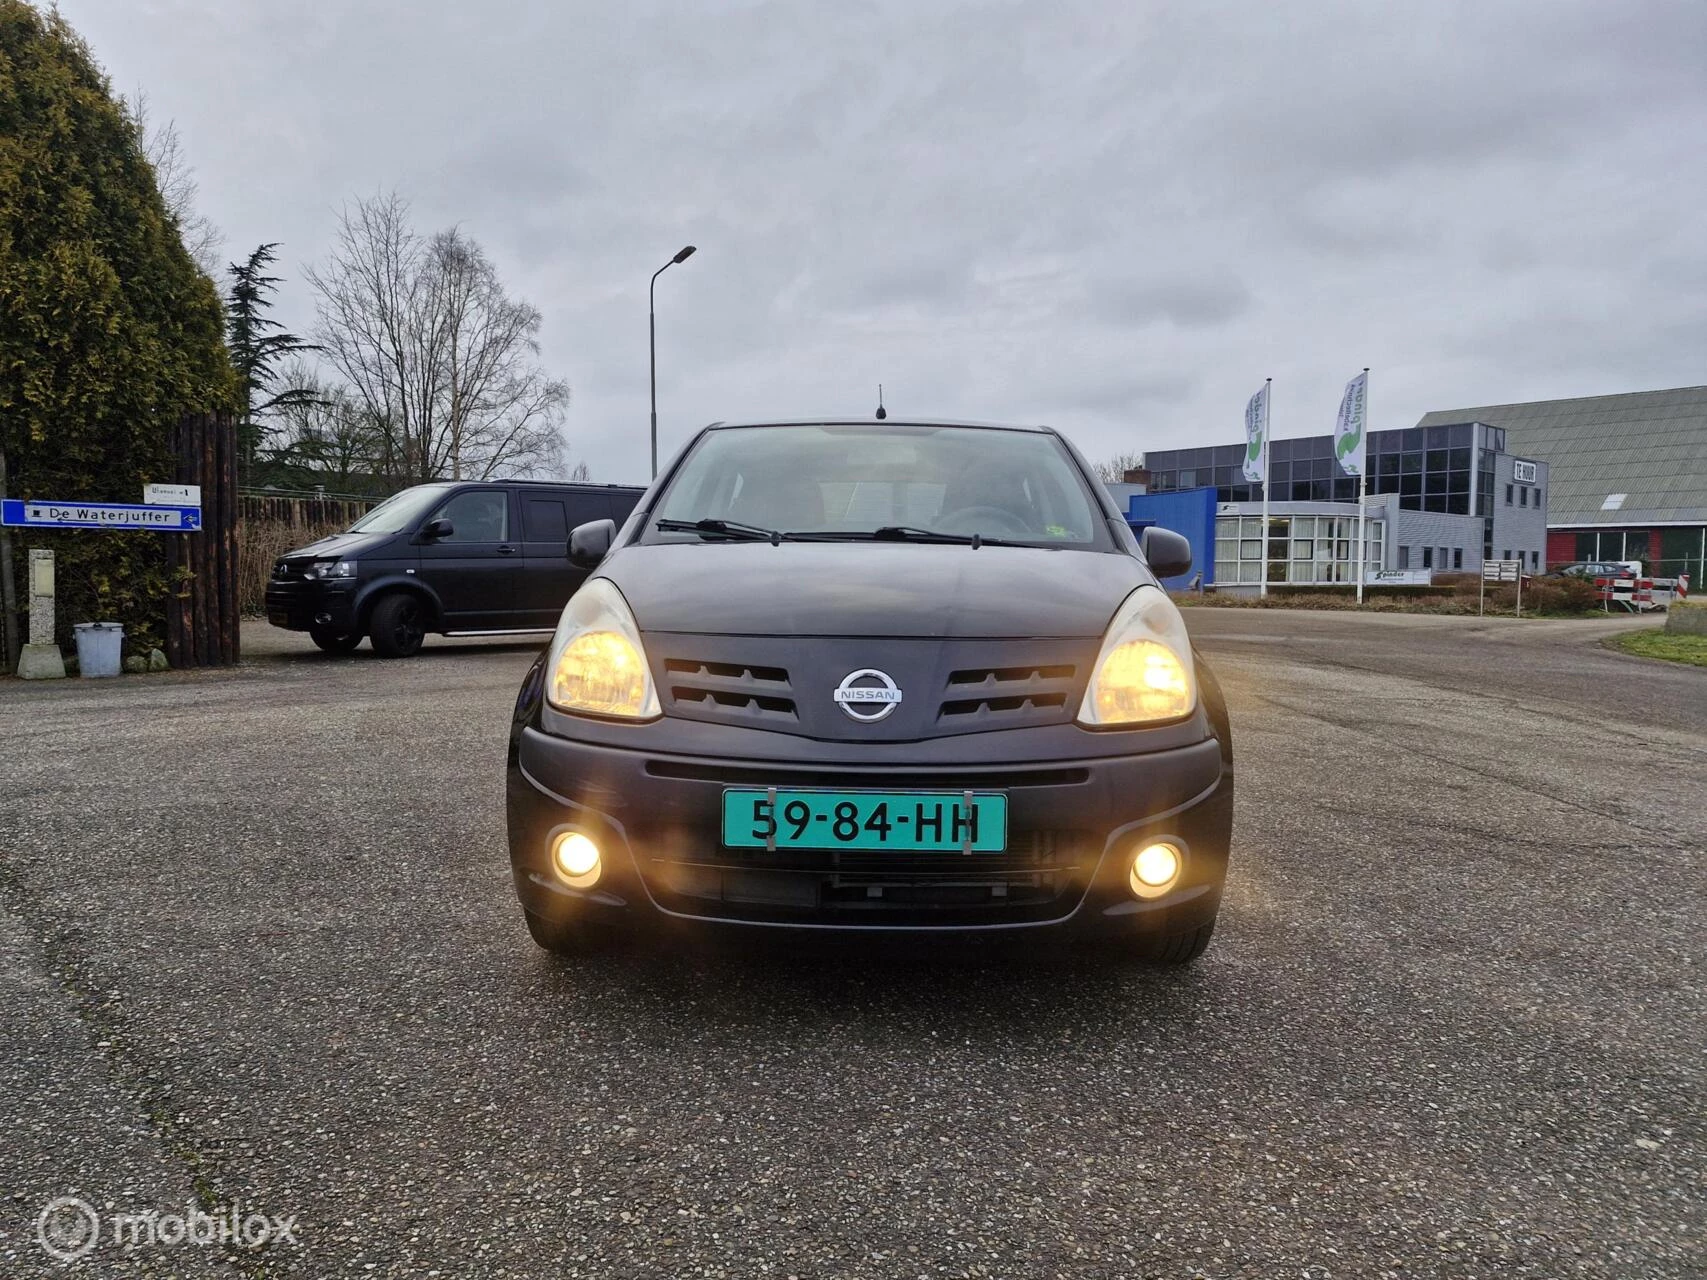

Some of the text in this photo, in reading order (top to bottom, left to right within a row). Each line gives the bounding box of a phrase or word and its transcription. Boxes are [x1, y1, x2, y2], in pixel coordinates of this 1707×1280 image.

[1516, 463, 1522, 479] TE
[49, 507, 170, 524] De Waterjuffer
[840, 690, 895, 700] NISSAN
[752, 799, 979, 843] 59-84-HH
